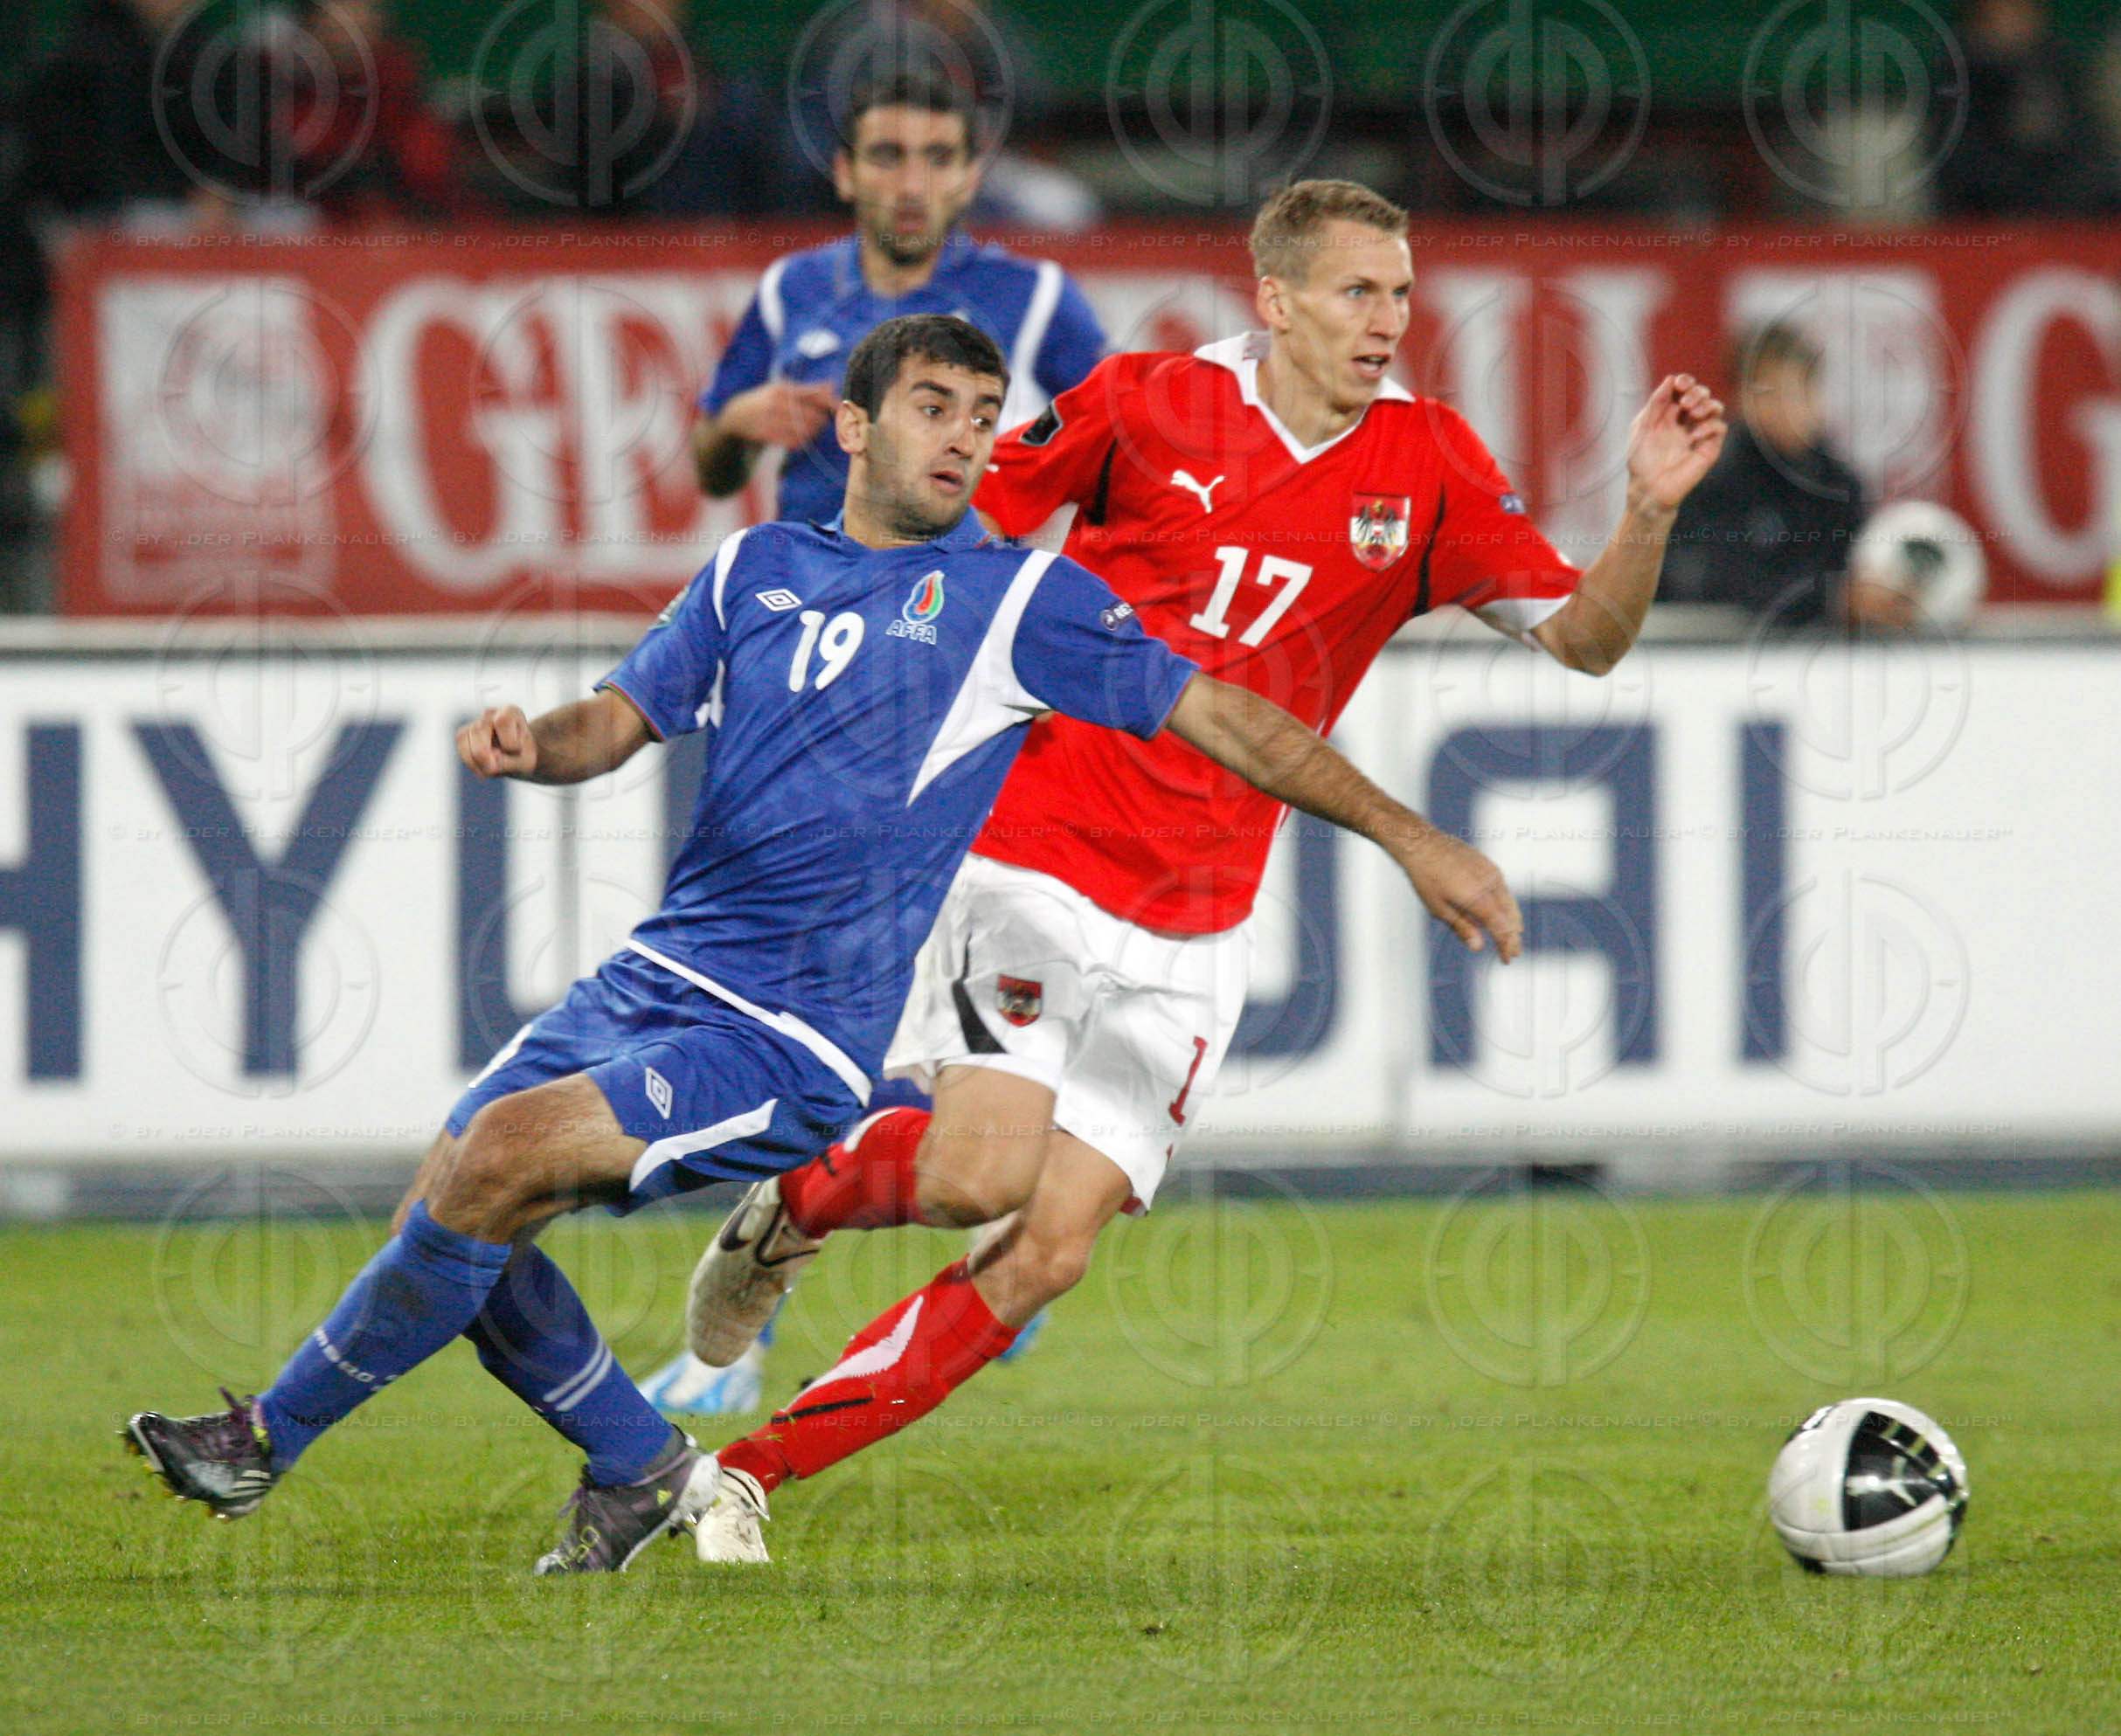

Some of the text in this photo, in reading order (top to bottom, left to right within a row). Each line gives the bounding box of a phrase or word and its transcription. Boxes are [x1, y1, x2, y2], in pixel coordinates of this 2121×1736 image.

[885, 619, 938, 646] AFFA
[1189, 546, 1313, 647] 17
[789, 610, 864, 692] 19
